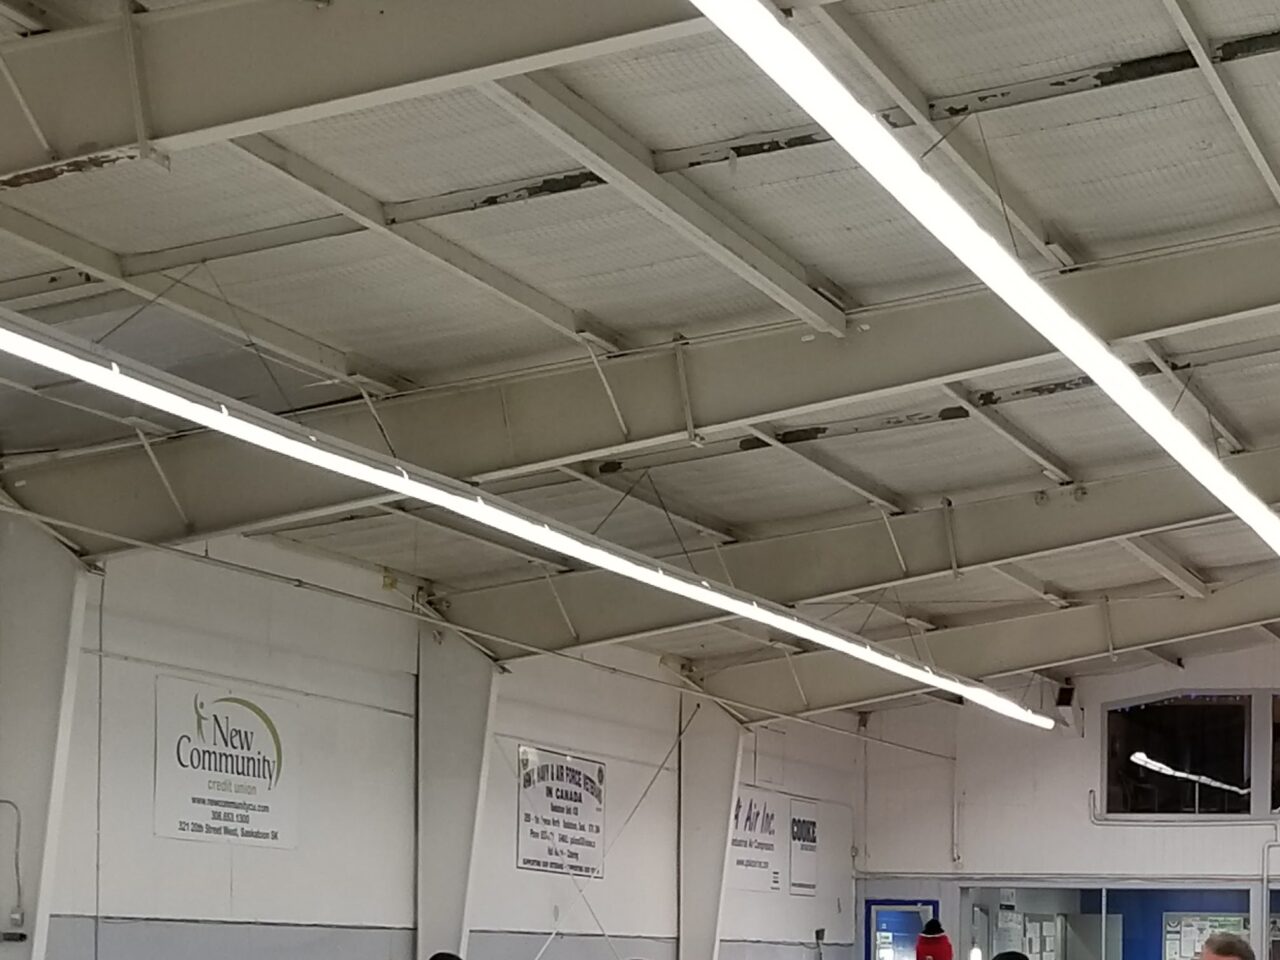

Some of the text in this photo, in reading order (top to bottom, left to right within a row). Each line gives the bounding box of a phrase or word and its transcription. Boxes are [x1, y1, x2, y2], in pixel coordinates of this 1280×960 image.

[213, 714, 254, 752] New
[176, 734, 275, 791] Community
[207, 780, 257, 796] credit union
[555, 787, 583, 804] CANADA
[744, 798, 761, 833] Air
